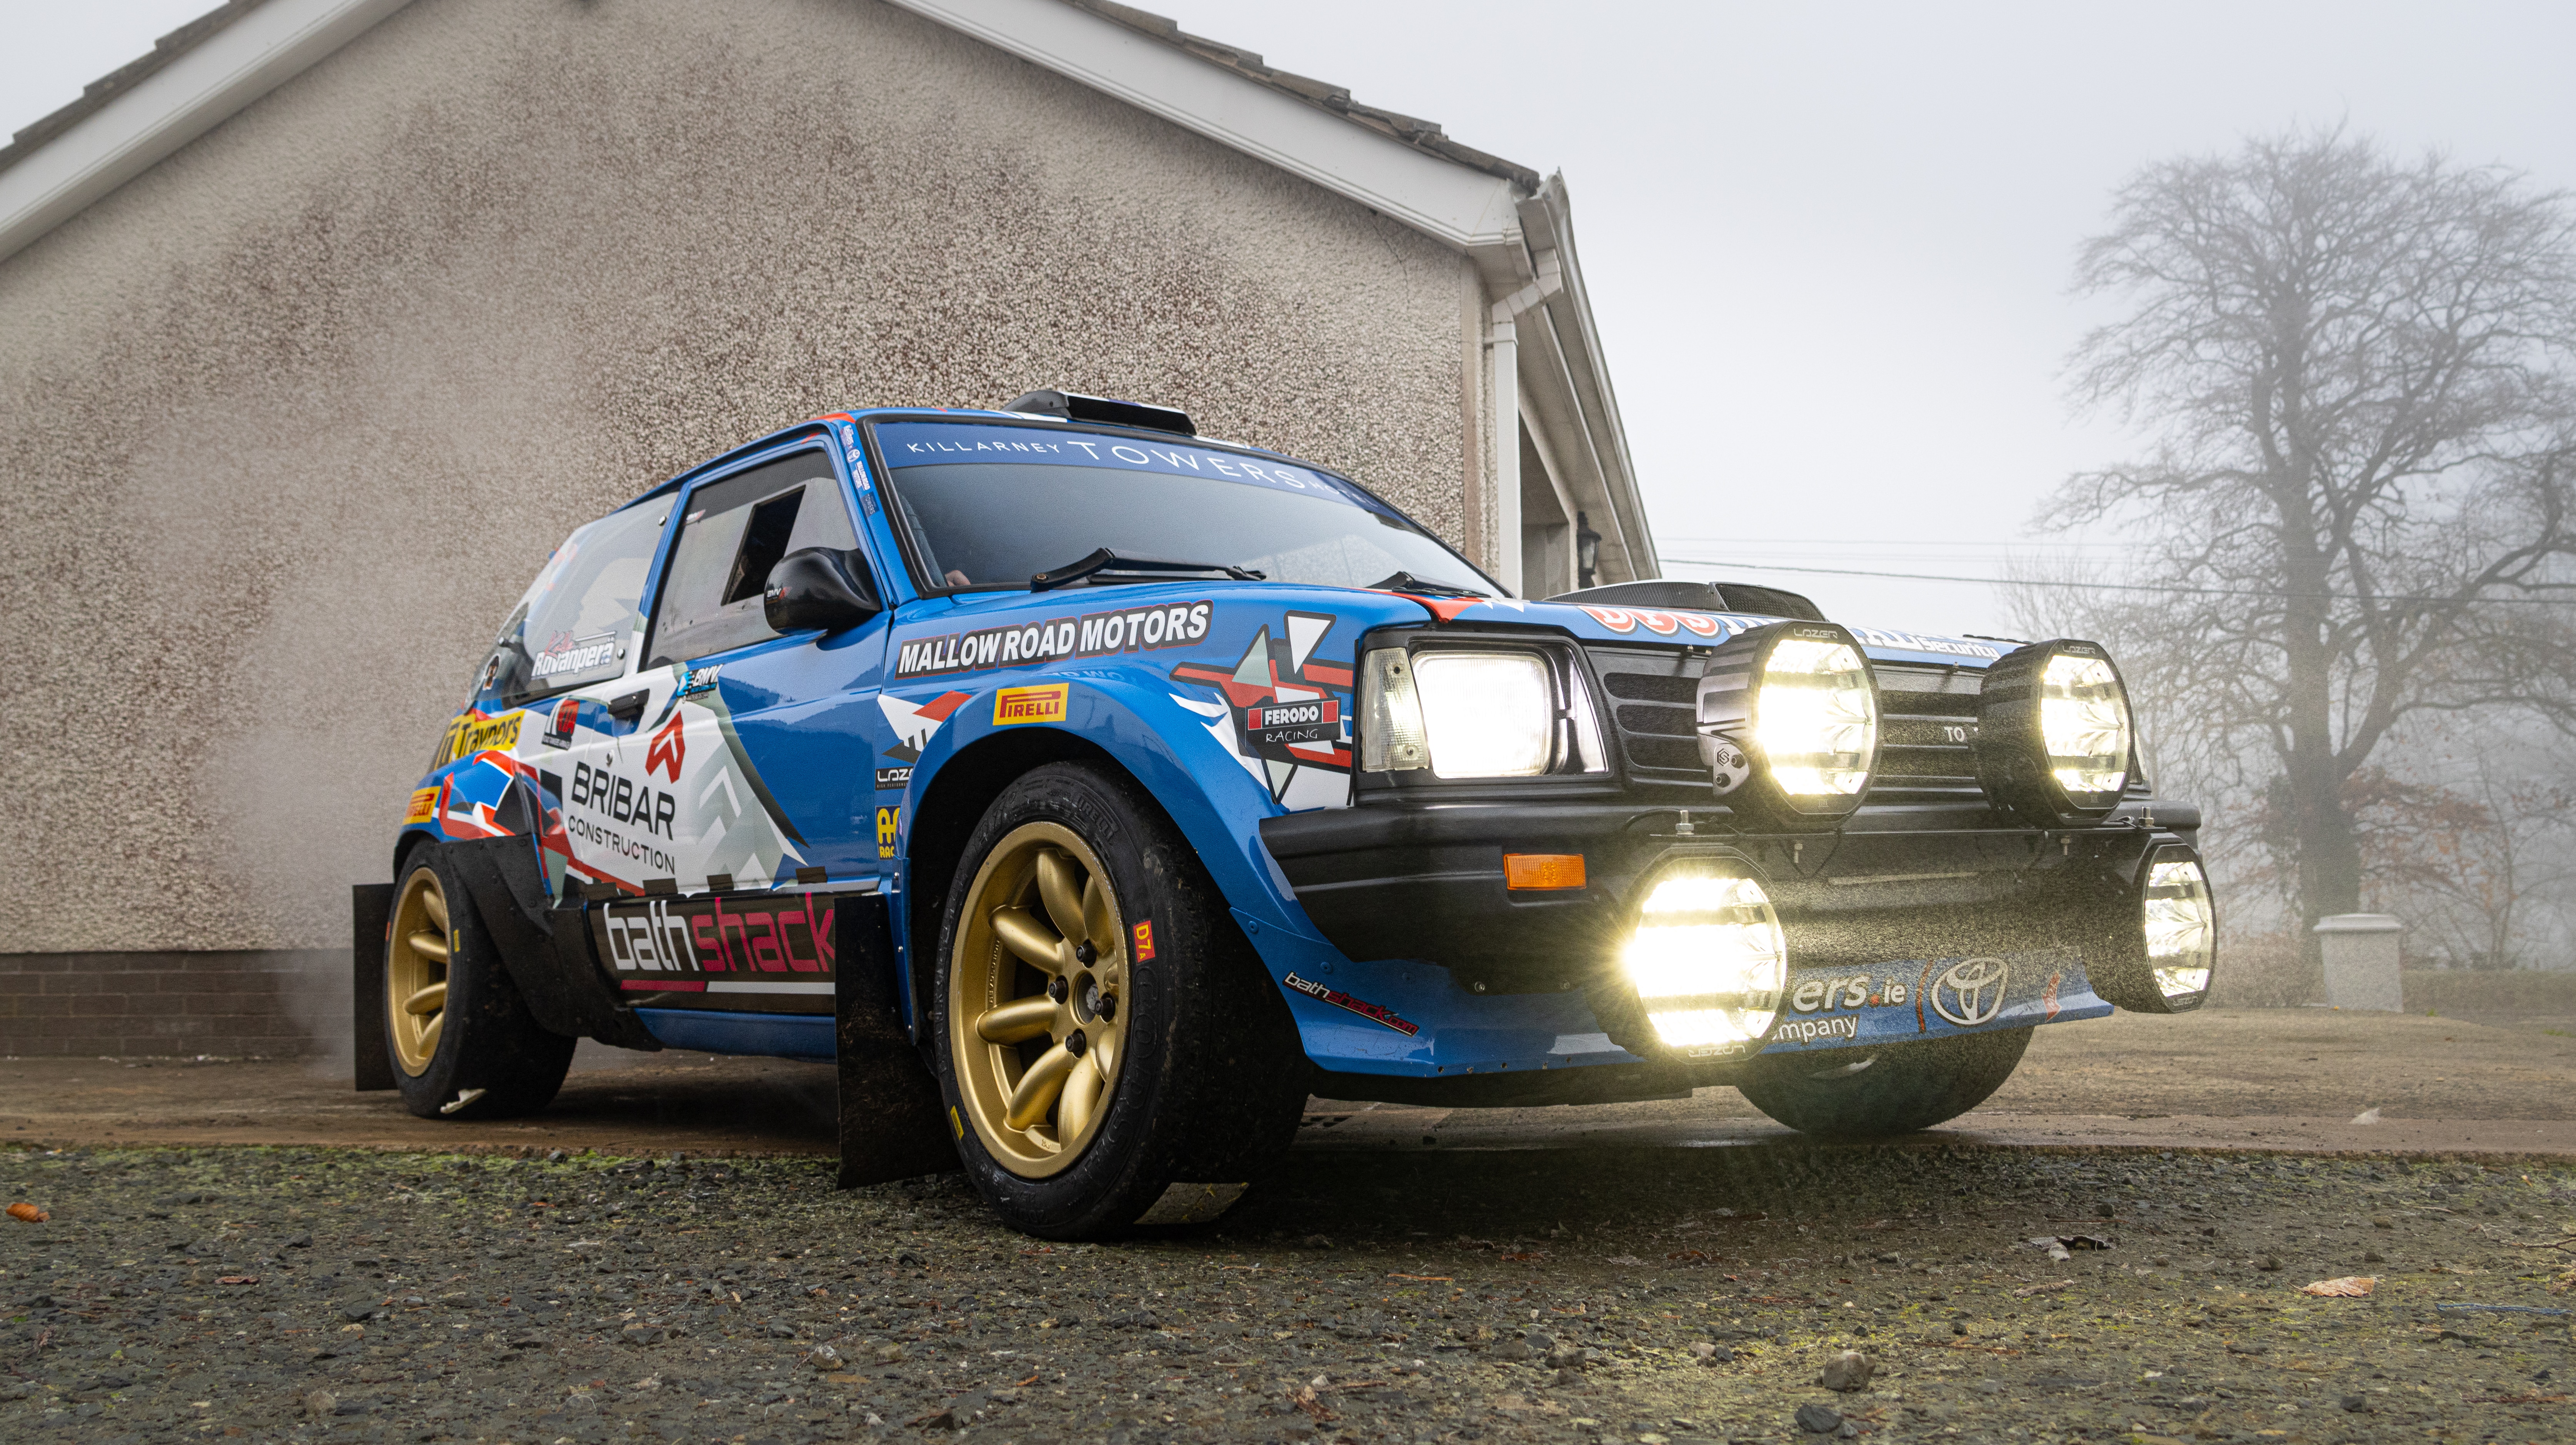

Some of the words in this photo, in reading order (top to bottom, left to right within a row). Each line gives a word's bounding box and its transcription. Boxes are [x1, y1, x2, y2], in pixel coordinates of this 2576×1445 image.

[907, 441, 1060, 453] KILLARNEY
[1067, 441, 1306, 489] TOWERS
[899, 632, 1001, 674] MALLOW
[1002, 622, 1076, 661] ROAD
[1079, 604, 1210, 653] MOTORS
[1793, 629, 1838, 639] LAZER
[1921, 637, 2001, 662] security
[2062, 645, 2096, 654] LAZER
[999, 691, 1061, 718] PIRELLI
[1265, 705, 1319, 726] FERODO
[1265, 728, 1318, 743] RACING
[571, 761, 675, 841] BRIBAR
[568, 815, 675, 875] CONSTRUCTION
[604, 892, 835, 973] bathshack
[1285, 971, 1419, 1035] bathshack.com
[1792, 974, 1906, 1011] ers.ie
